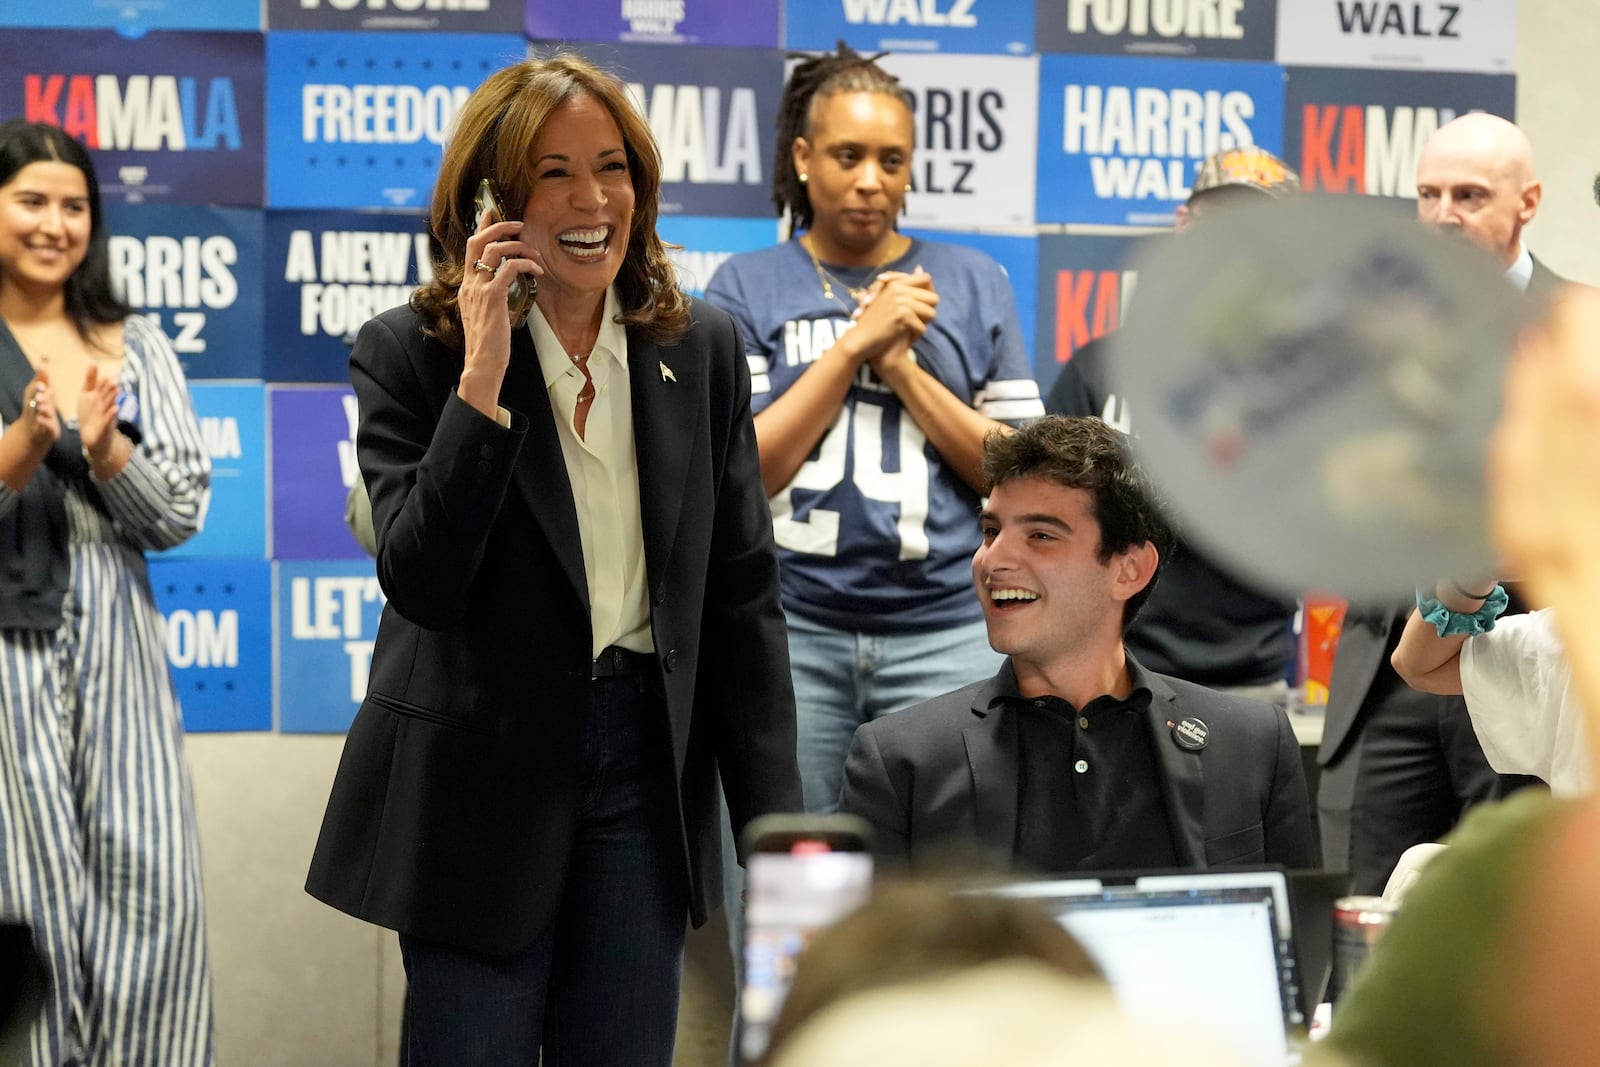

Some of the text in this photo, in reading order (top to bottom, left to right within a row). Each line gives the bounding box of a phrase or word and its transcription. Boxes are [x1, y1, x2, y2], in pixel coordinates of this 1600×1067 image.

[841, 0, 978, 28] WALZ
[1336, 0, 1460, 38] WALZ
[24, 74, 242, 151] KAMALA
[622, 82, 762, 185] MALA
[903, 89, 1003, 151] RIS
[1064, 84, 1254, 158] HARRIS
[910, 161, 974, 193] LZ
[1090, 157, 1203, 199] WAL
[108, 235, 238, 310] RRIS
[285, 230, 317, 282] A
[321, 231, 411, 284] NEW
[768, 400, 929, 560] 24
[291, 576, 388, 639] LET'
[1181, 720, 1207, 738] end gun
